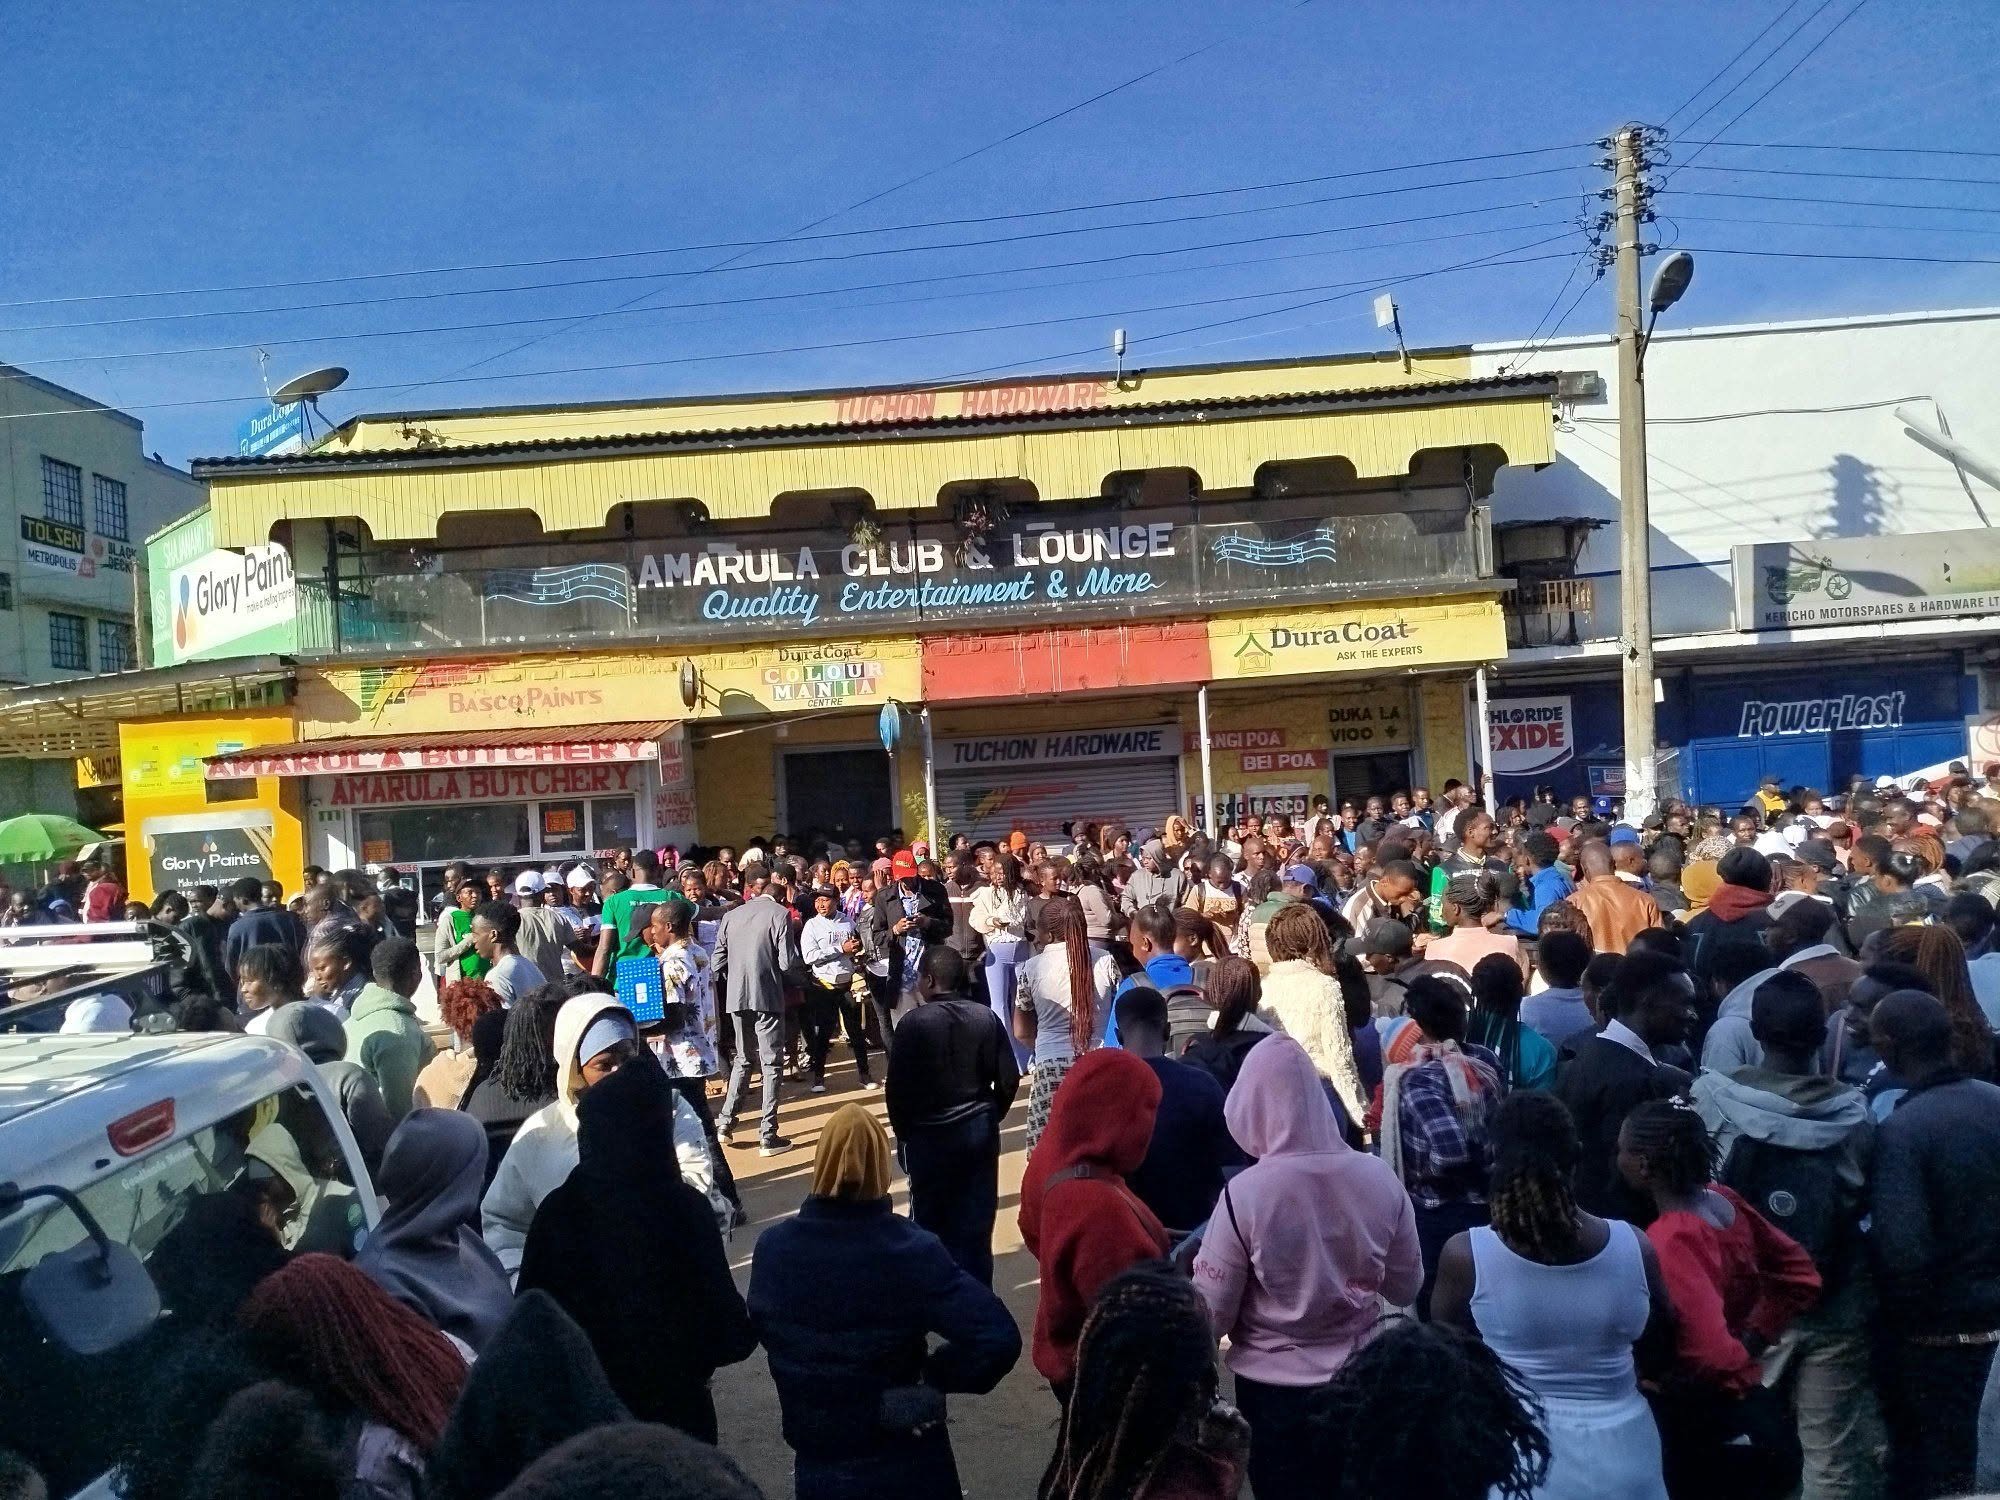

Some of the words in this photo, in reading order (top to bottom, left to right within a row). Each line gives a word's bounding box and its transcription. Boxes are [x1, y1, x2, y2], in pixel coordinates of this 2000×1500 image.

[834, 393, 937, 421] TUCHON
[961, 382, 1108, 416] HARDWARE
[24, 518, 82, 550] TOLSEN
[28, 548, 77, 571] METROPOLIS
[107, 541, 137, 559] BLACK
[638, 546, 820, 589] AMARULA
[841, 539, 944, 577] CLUB
[965, 536, 994, 570] &
[1013, 522, 1175, 567] LOUNGE
[197, 571, 240, 616] Glory
[703, 585, 820, 626] Quality
[840, 571, 1035, 612] Entertainment
[1047, 569, 1068, 599] &
[1076, 566, 1167, 596] More
[1765, 608, 1815, 624] KERICHO
[1820, 603, 1904, 620] MOTORSPARES
[1908, 601, 1916, 613] &
[1920, 596, 1984, 612] HARDWARE
[1336, 651, 1357, 661] ASK
[1361, 649, 1378, 659] THE
[1382, 645, 1423, 657] EXPERTS
[763, 661, 885, 685] COLOUR
[773, 679, 875, 701] MANIA
[807, 697, 844, 708] CENTRE
[1328, 707, 1372, 723] DUKA
[1380, 706, 1400, 720] LA
[1488, 706, 1563, 724] HLORIDE
[1738, 691, 1905, 737] PowerLast
[1246, 730, 1281, 747] POA
[1329, 726, 1374, 742] VIOO
[953, 738, 1037, 763] TUCHON
[1045, 729, 1164, 758] HARDWARE
[208, 748, 405, 777] AMARULA
[422, 741, 644, 766] BUTCHERY
[1243, 755, 1272, 771] BEI
[1278, 752, 1316, 768] POA
[331, 771, 462, 805] AMARULA
[469, 763, 634, 799] BUTCHERY
[1195, 802, 1246, 816] BSCO
[162, 857, 207, 873] Glory
[209, 852, 261, 868] Paints
[177, 878, 193, 888] Make
